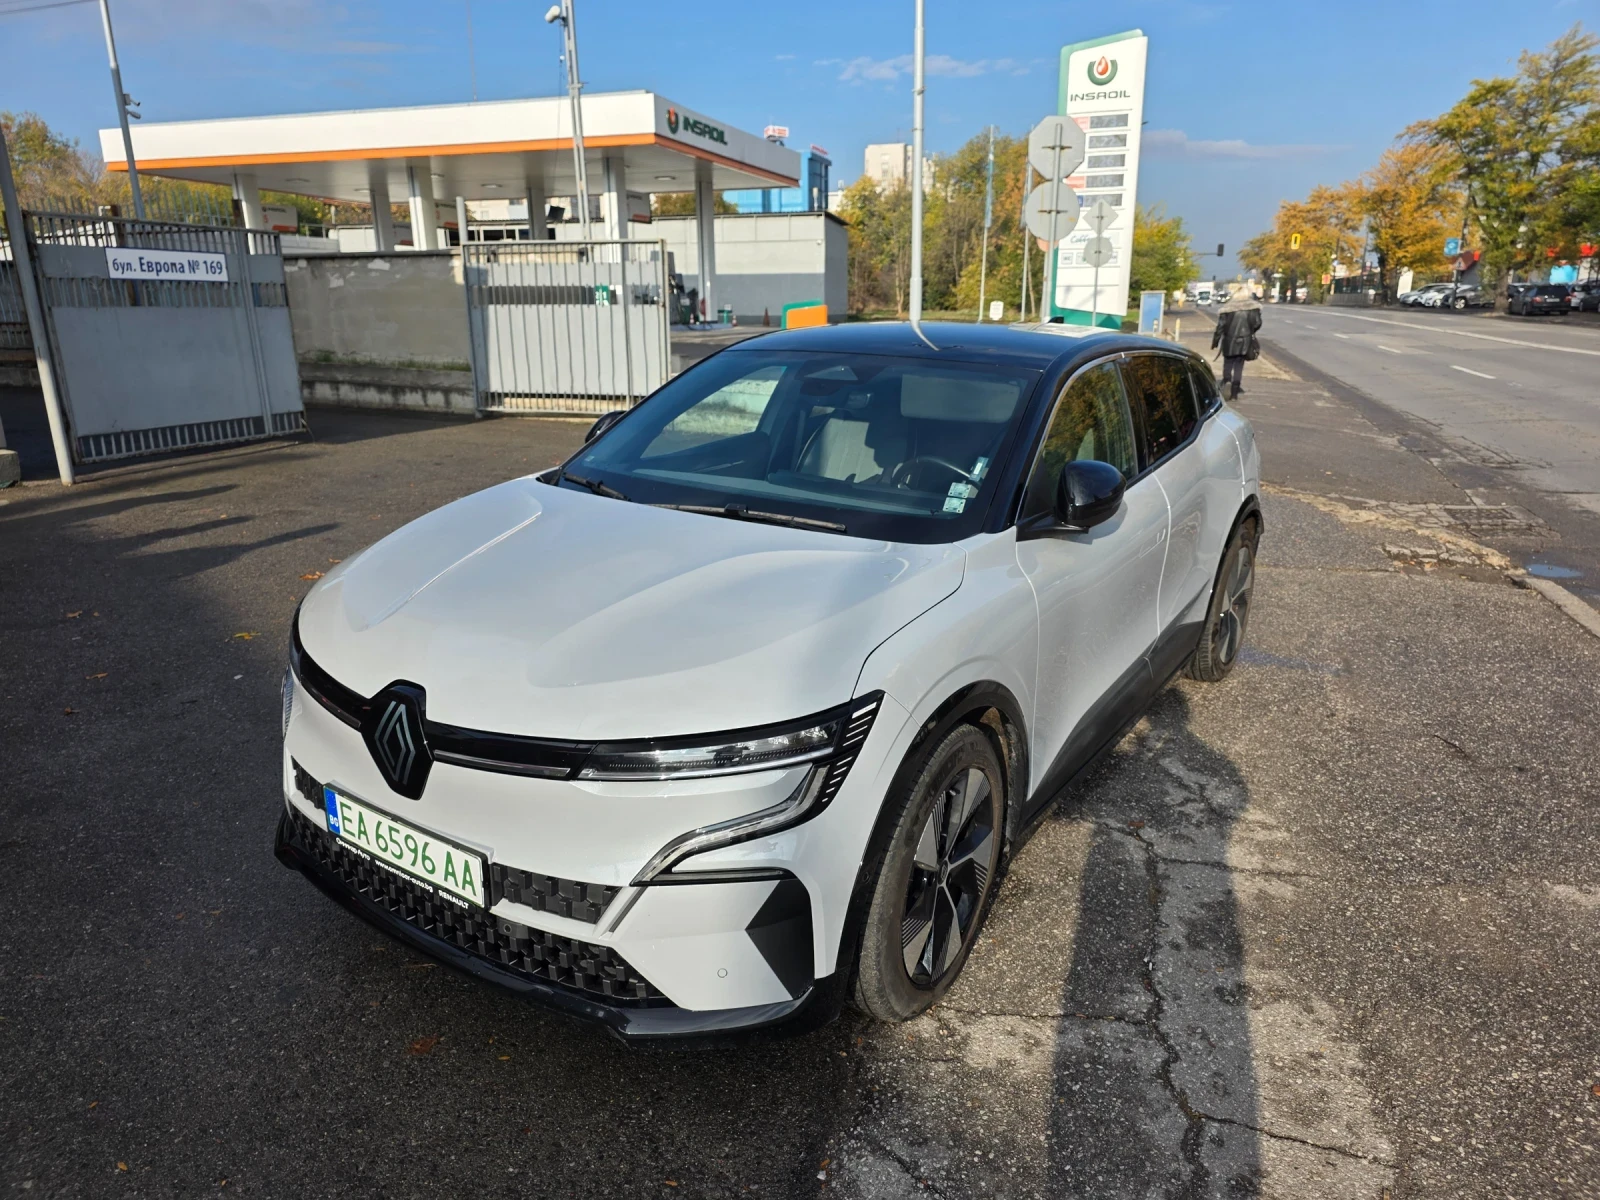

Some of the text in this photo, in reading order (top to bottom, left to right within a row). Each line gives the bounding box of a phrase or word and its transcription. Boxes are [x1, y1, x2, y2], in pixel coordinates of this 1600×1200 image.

[1070, 90, 1131, 102] INSAOIL
[112, 256, 223, 276] бул. Европа № 169
[329, 814, 339, 827] BG
[339, 801, 477, 897] EA 6596 AA
[438, 889, 470, 909] RENAULT
